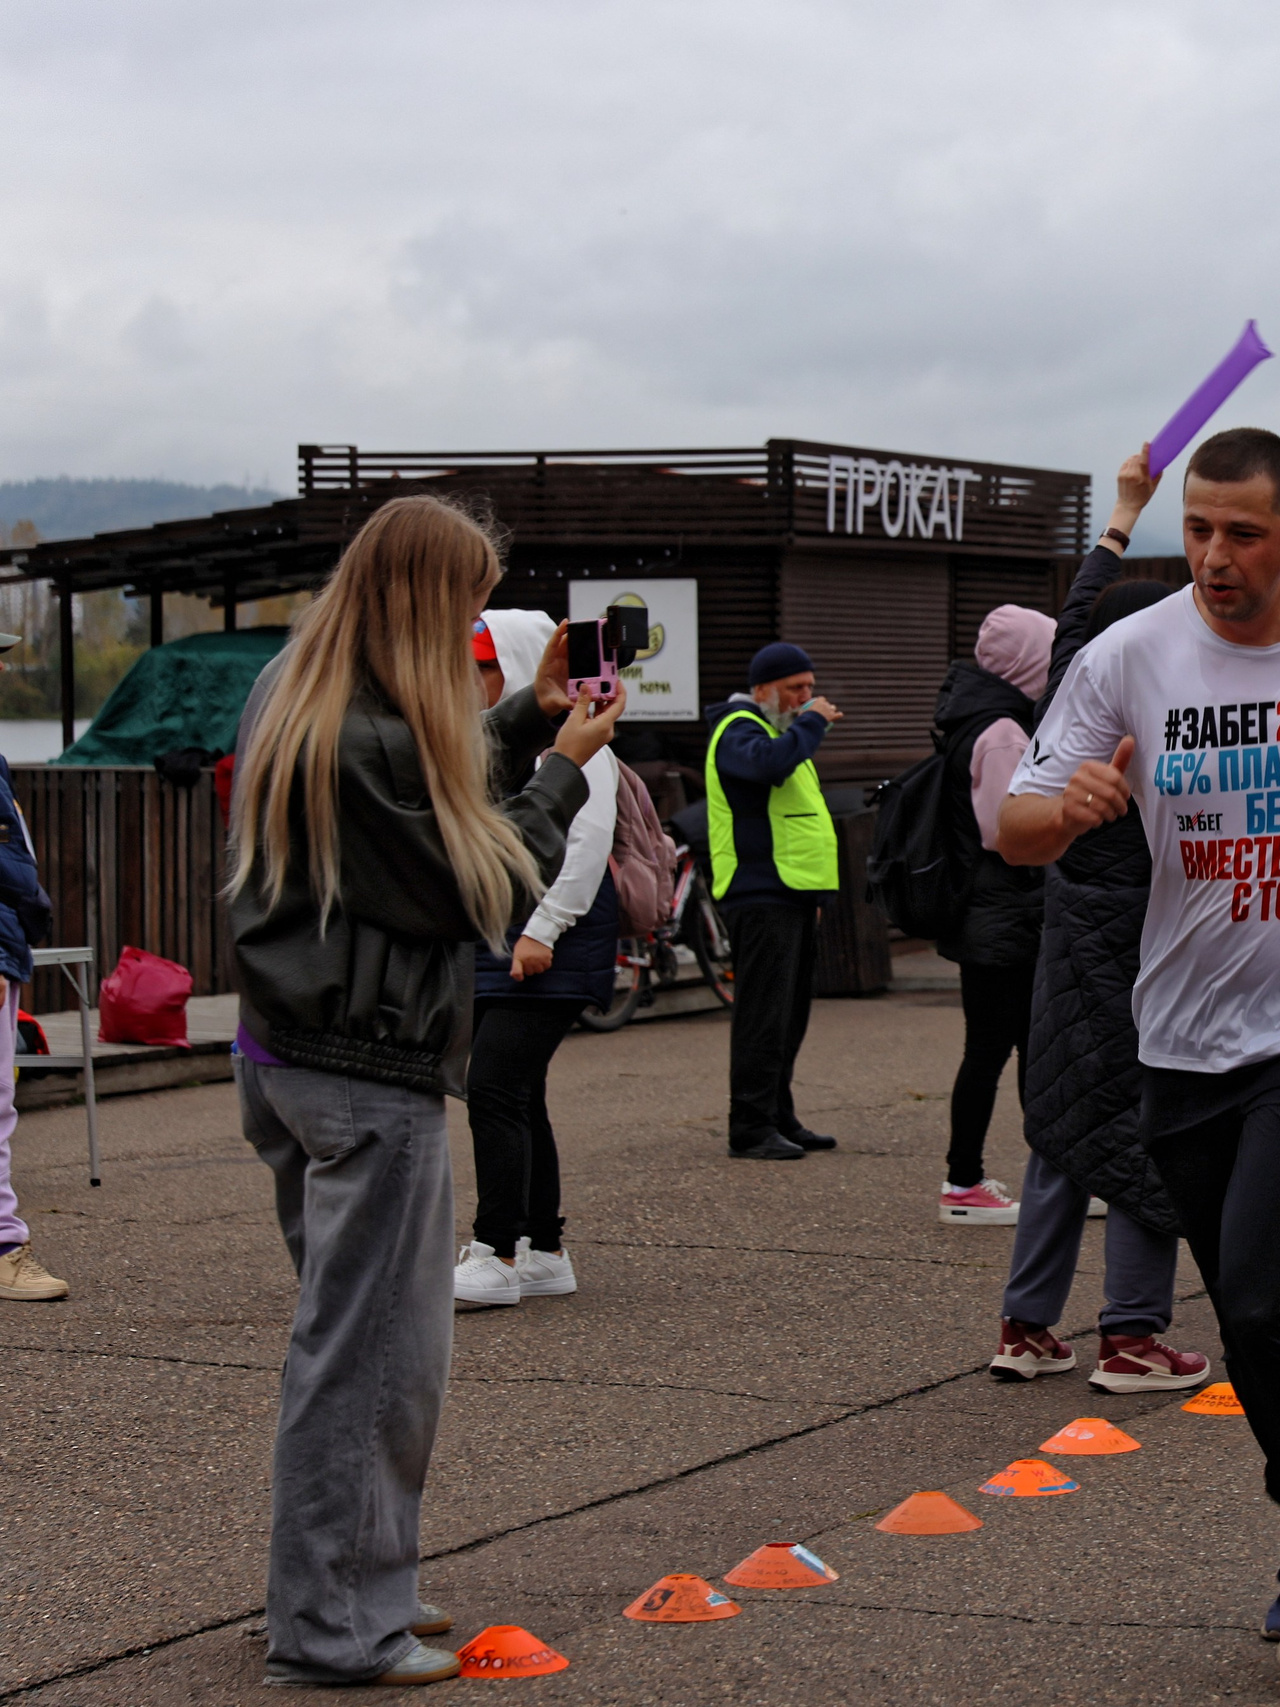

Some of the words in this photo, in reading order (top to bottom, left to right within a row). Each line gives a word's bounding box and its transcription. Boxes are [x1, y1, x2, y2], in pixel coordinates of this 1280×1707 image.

[827, 454, 973, 541] ПРОКАТ
[1154, 750, 1211, 796] 45%
[1231, 883, 1252, 923] С
